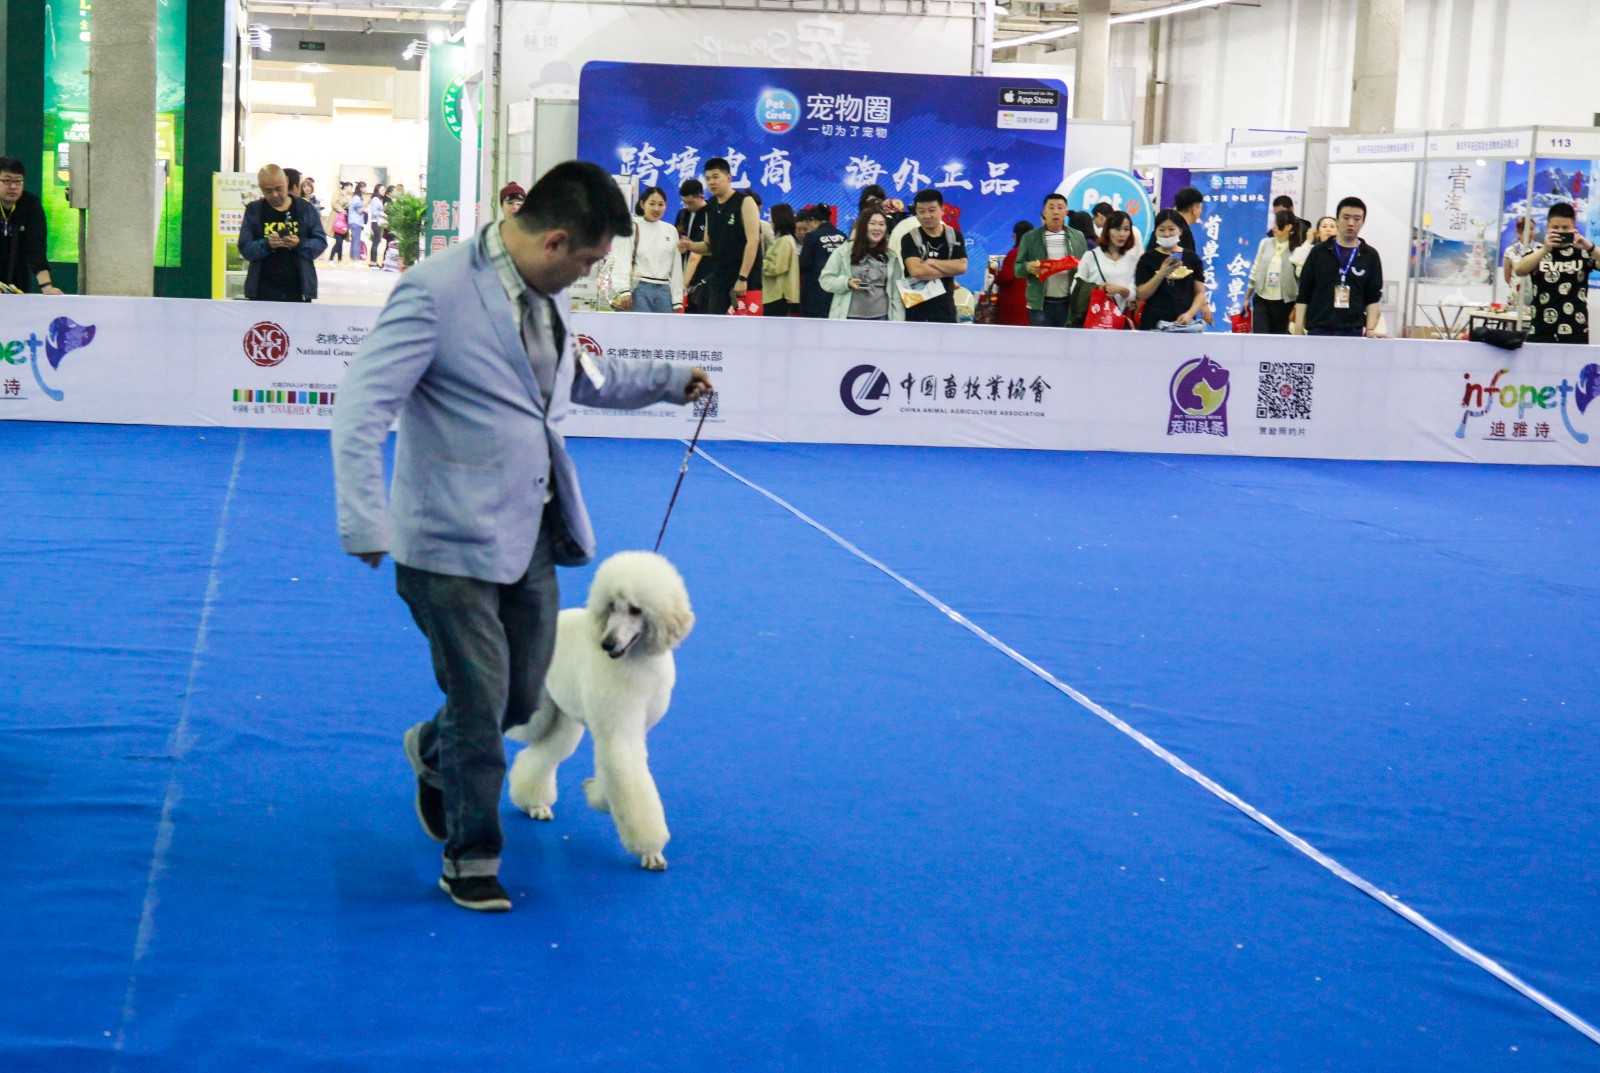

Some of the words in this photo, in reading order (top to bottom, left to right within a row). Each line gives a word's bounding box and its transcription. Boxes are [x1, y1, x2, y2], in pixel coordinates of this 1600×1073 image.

[765, 99, 784, 109] Pet
[806, 93, 891, 123] 宠物圈
[1016, 95, 1034, 105] App
[1034, 96, 1055, 105] Store
[765, 109, 792, 120] Circle
[807, 124, 888, 139] 一切为了宠物
[1551, 139, 1571, 148] 113
[619, 142, 792, 193] 跨境电商
[843, 155, 1020, 196] 海外正品
[1445, 165, 1471, 231] 青海湖
[1539, 260, 1583, 272] EVISU
[296, 347, 331, 356] National
[333, 348, 356, 357] Gene
[607, 348, 723, 361] 名将宠物美容师俱乐部
[4, 378, 21, 396] 诗
[1455, 368, 1589, 443] infopet
[1170, 420, 1225, 437] 宠讯头条
[1490, 421, 1550, 438] 迪雅诗
